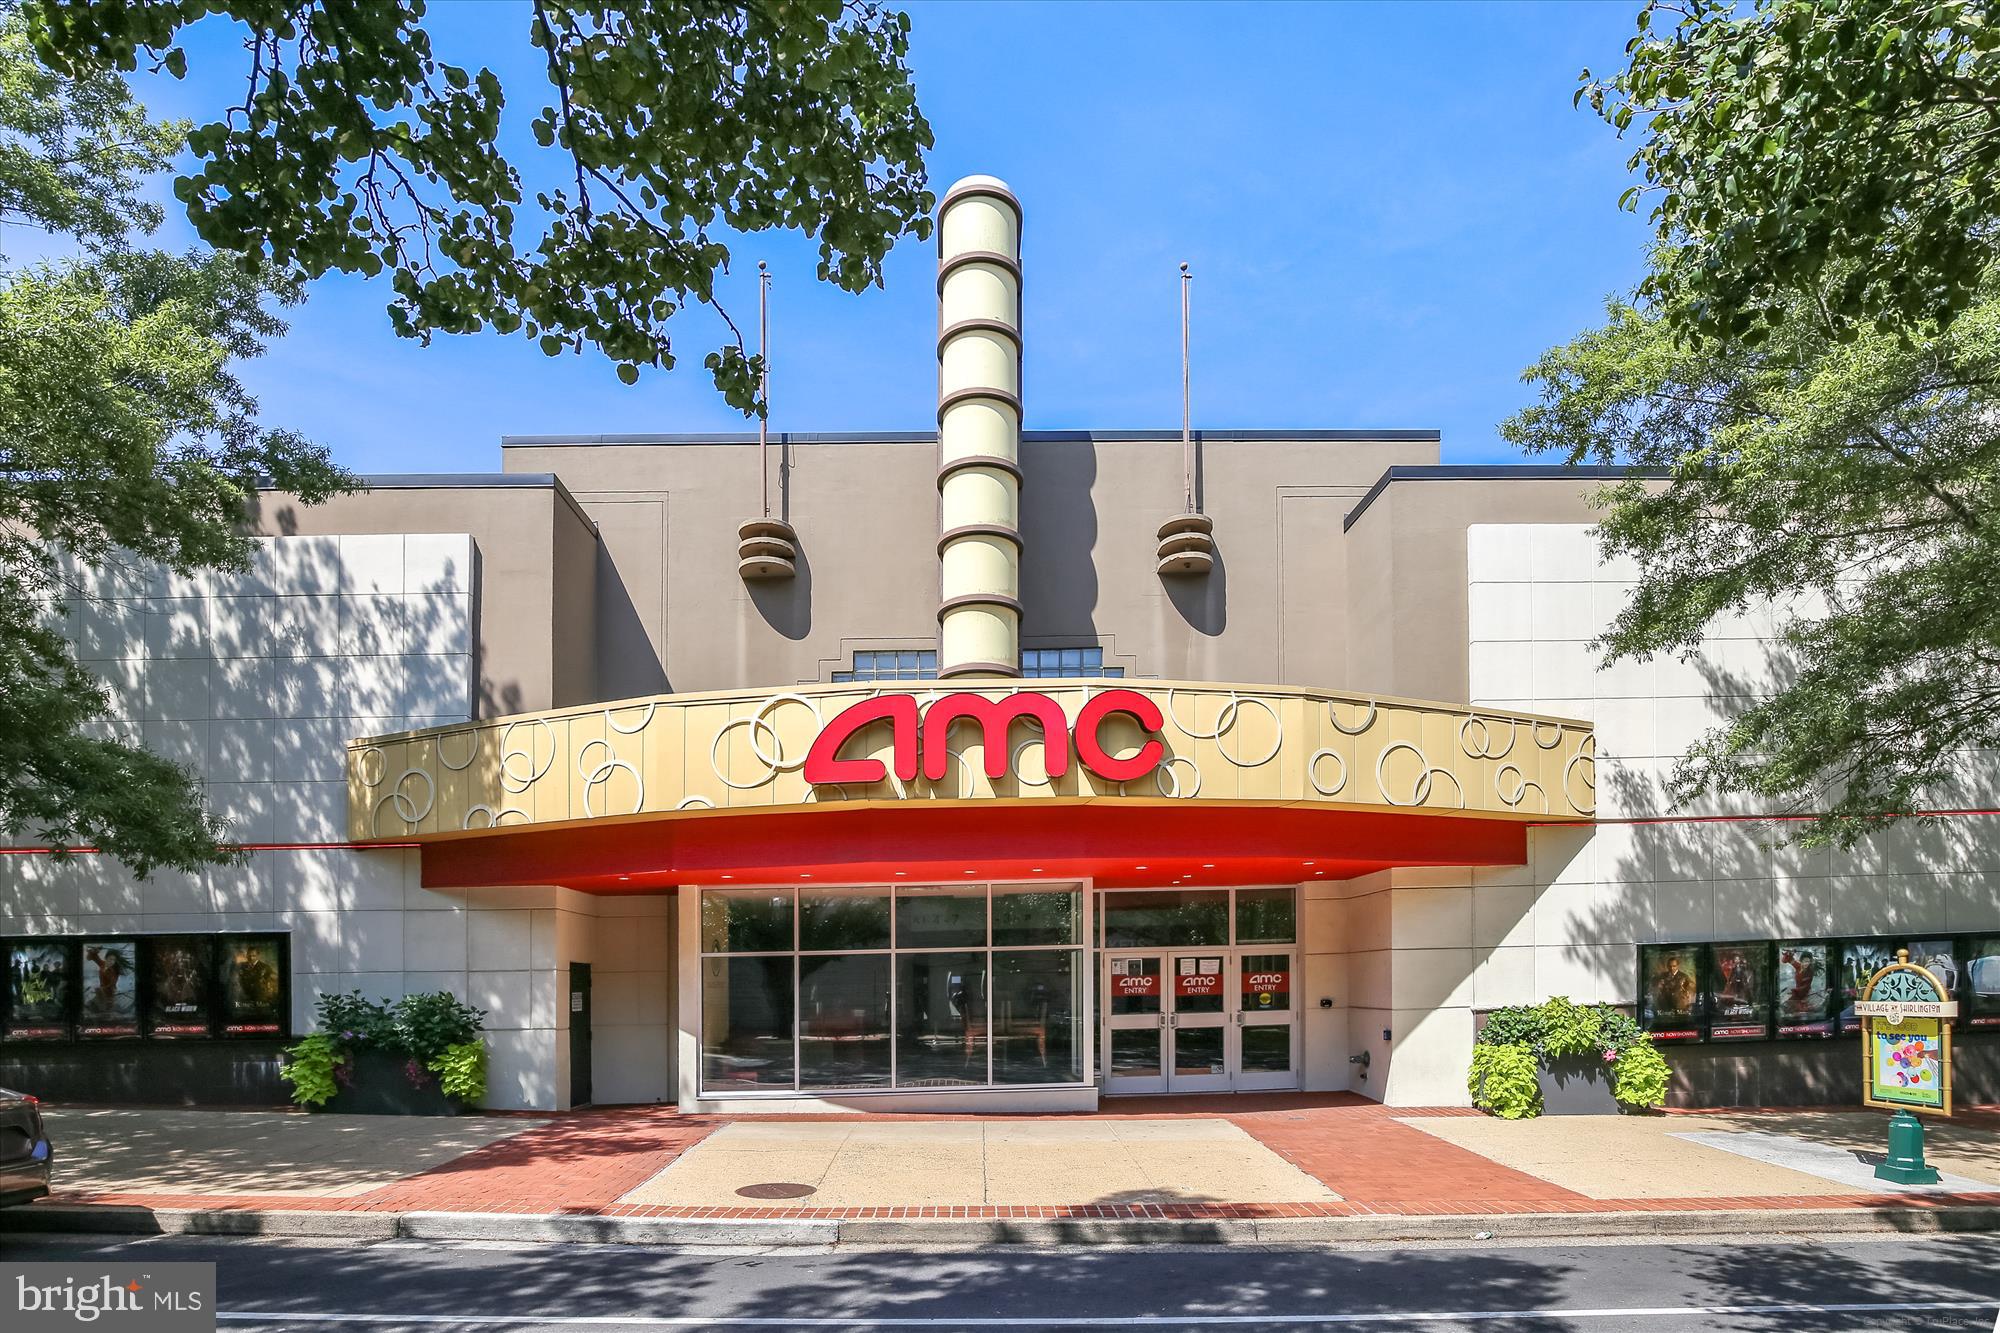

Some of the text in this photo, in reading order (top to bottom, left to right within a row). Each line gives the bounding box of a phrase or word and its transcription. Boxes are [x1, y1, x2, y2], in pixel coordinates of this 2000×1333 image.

[1187, 986, 1210, 994] ENTRY
[1254, 984, 1276, 992] ENTRY
[1862, 1003, 1889, 1012] VILLAGE
[1900, 1003, 1941, 1013] SHIRLINGTON
[1876, 1031, 1927, 1043] to see you
